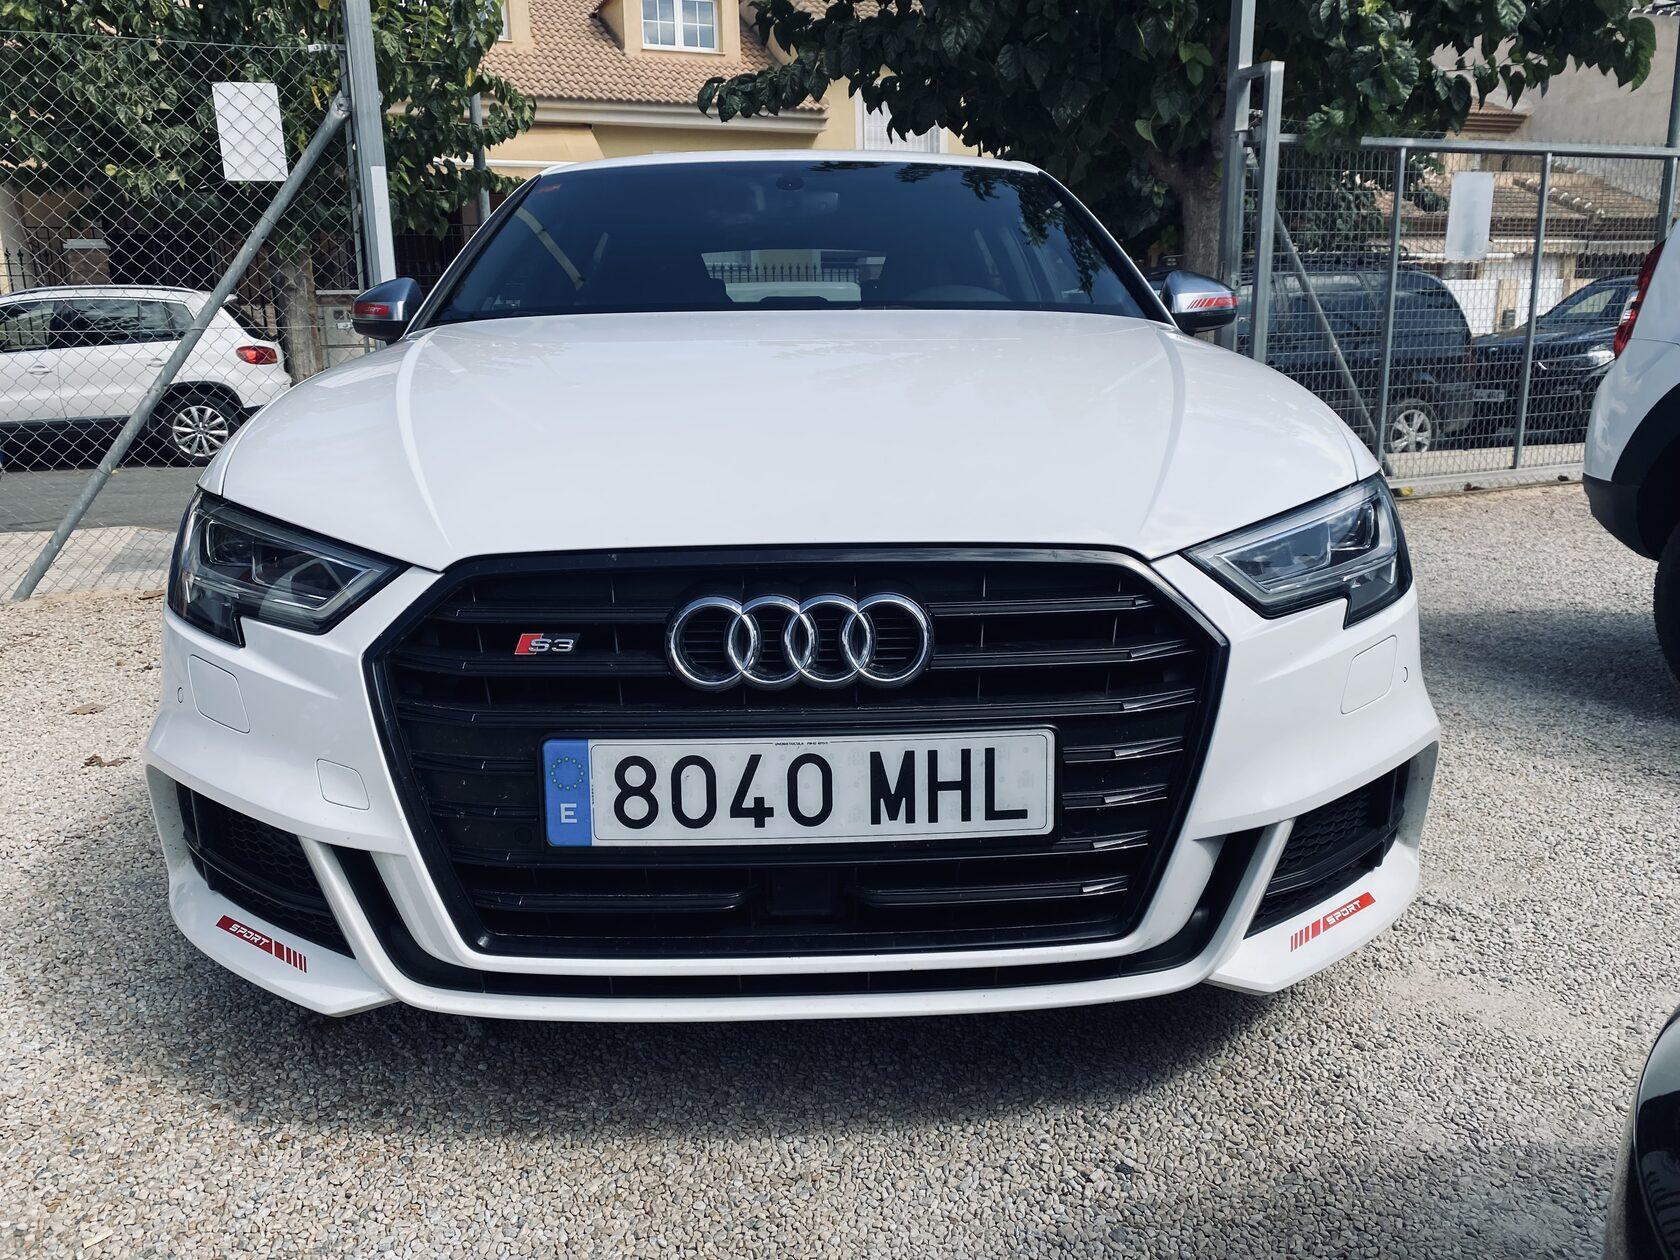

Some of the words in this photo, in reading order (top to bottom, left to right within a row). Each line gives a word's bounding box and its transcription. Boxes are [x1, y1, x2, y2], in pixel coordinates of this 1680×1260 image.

[528, 638, 574, 652] S3
[613, 752, 833, 830] 8040
[869, 747, 1028, 825] MHL
[560, 803, 577, 823] E
[1326, 900, 1361, 925] SPORT
[229, 923, 270, 946] SPORT
